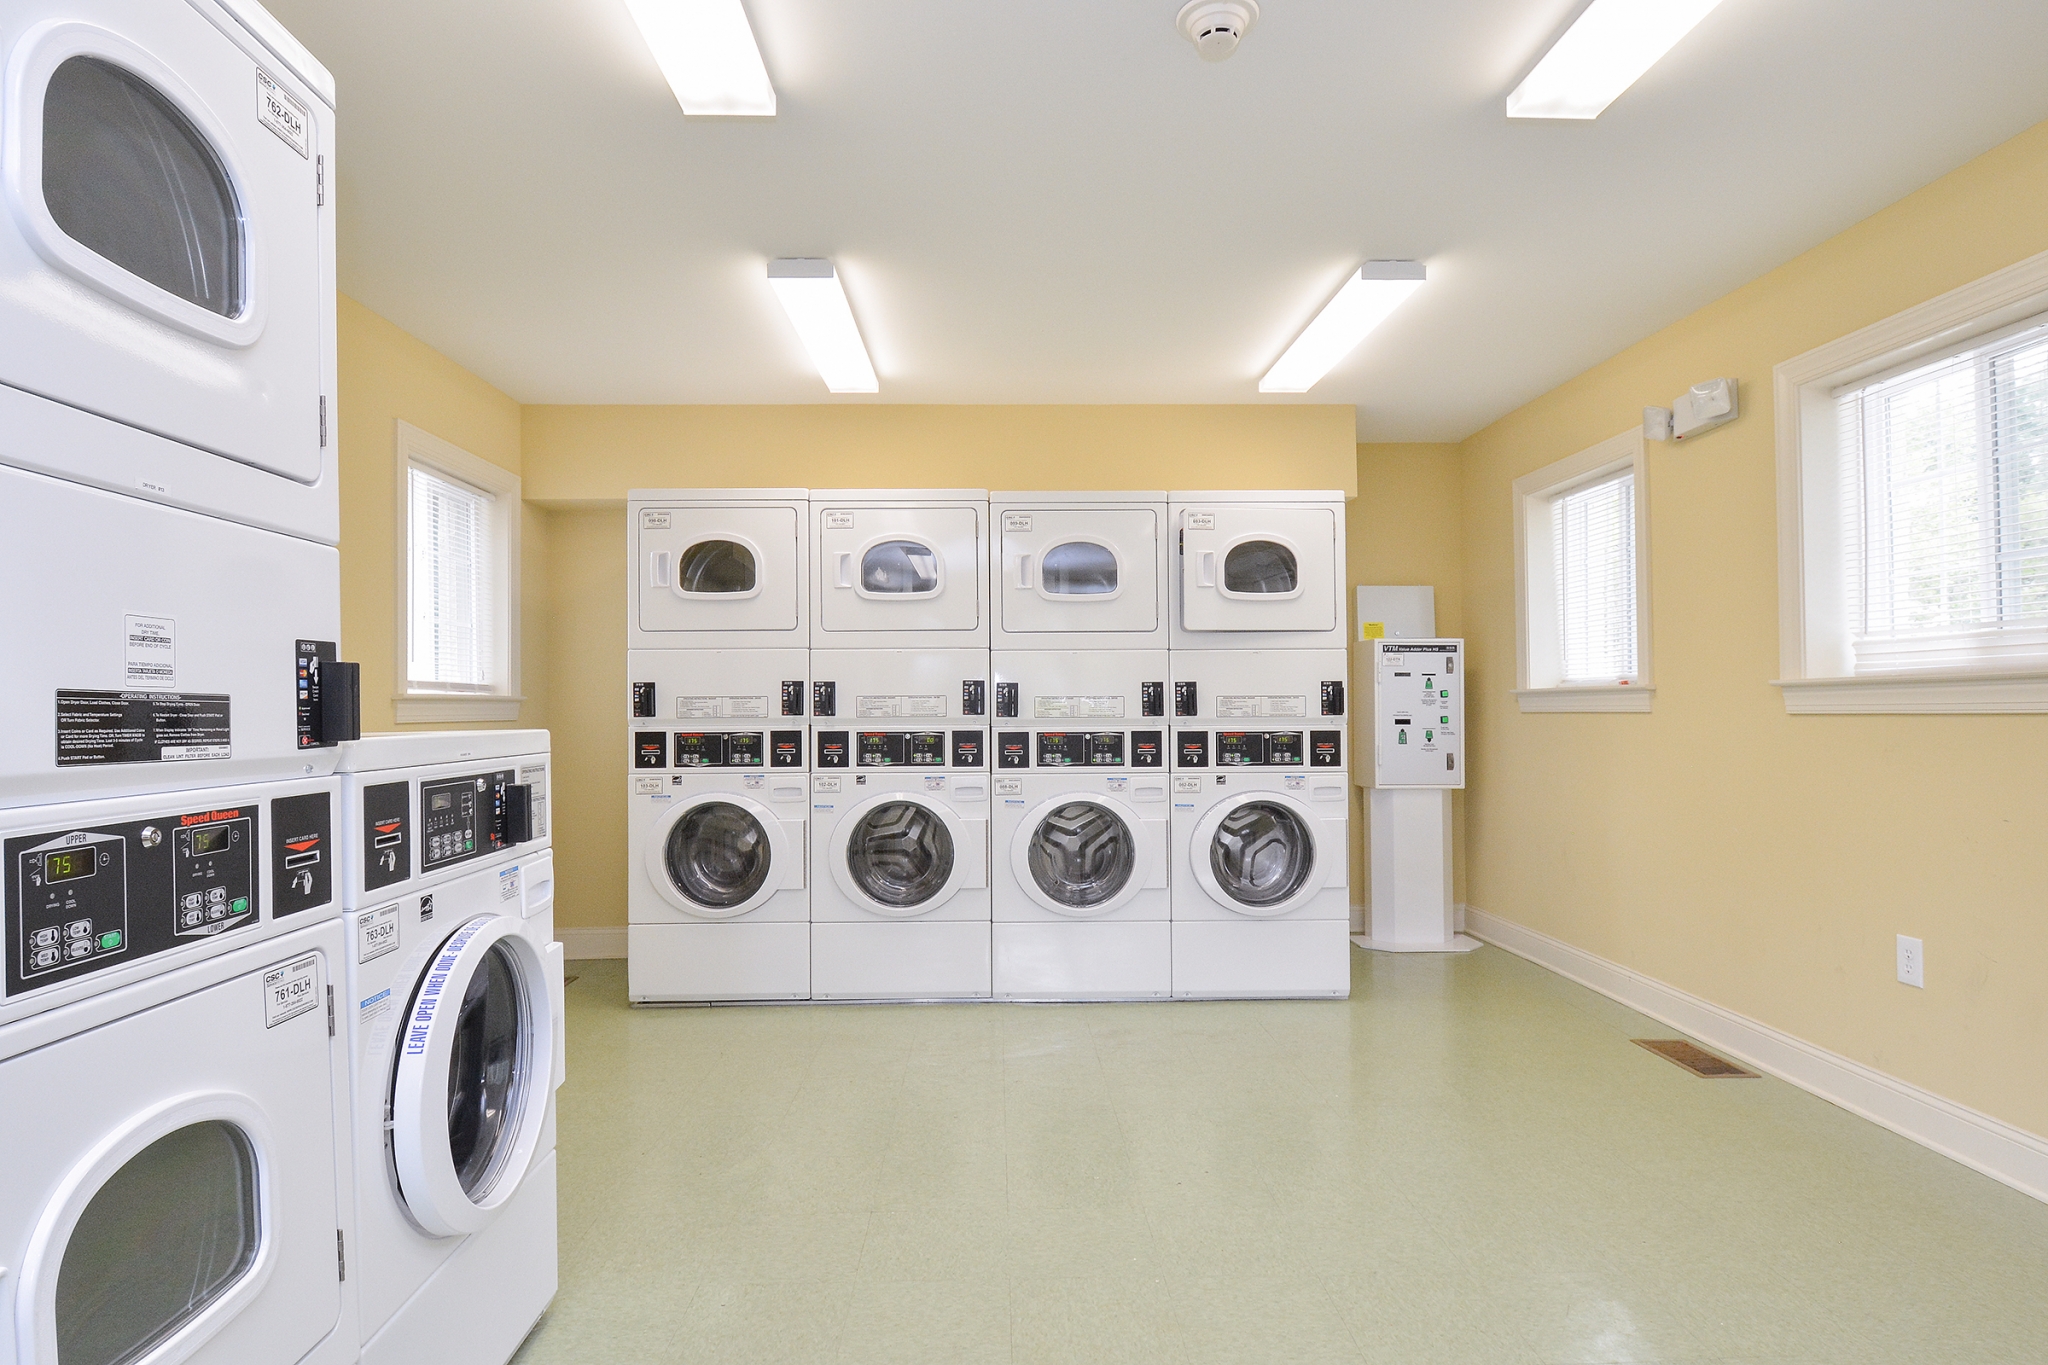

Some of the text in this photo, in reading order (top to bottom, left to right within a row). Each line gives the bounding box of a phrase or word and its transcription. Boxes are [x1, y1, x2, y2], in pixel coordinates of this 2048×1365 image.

[266, 96, 301, 134] 762-DLH
[181, 809, 239, 826] Speed Queen
[66, 833, 87, 845] UPPER
[196, 834, 209, 849] 75
[53, 856, 71, 874] 75
[207, 922, 224, 933] LOWER
[359, 916, 371, 925] CSC
[366, 923, 394, 942] 763-DLH
[435, 955, 458, 971] DONE
[266, 972, 280, 983] CSC
[424, 973, 447, 996] WHEN
[275, 978, 311, 1002] 761-DLH
[365, 992, 388, 1006] NOTICE
[415, 998, 437, 1021] OPEN
[407, 1024, 429, 1054] LEAVE
